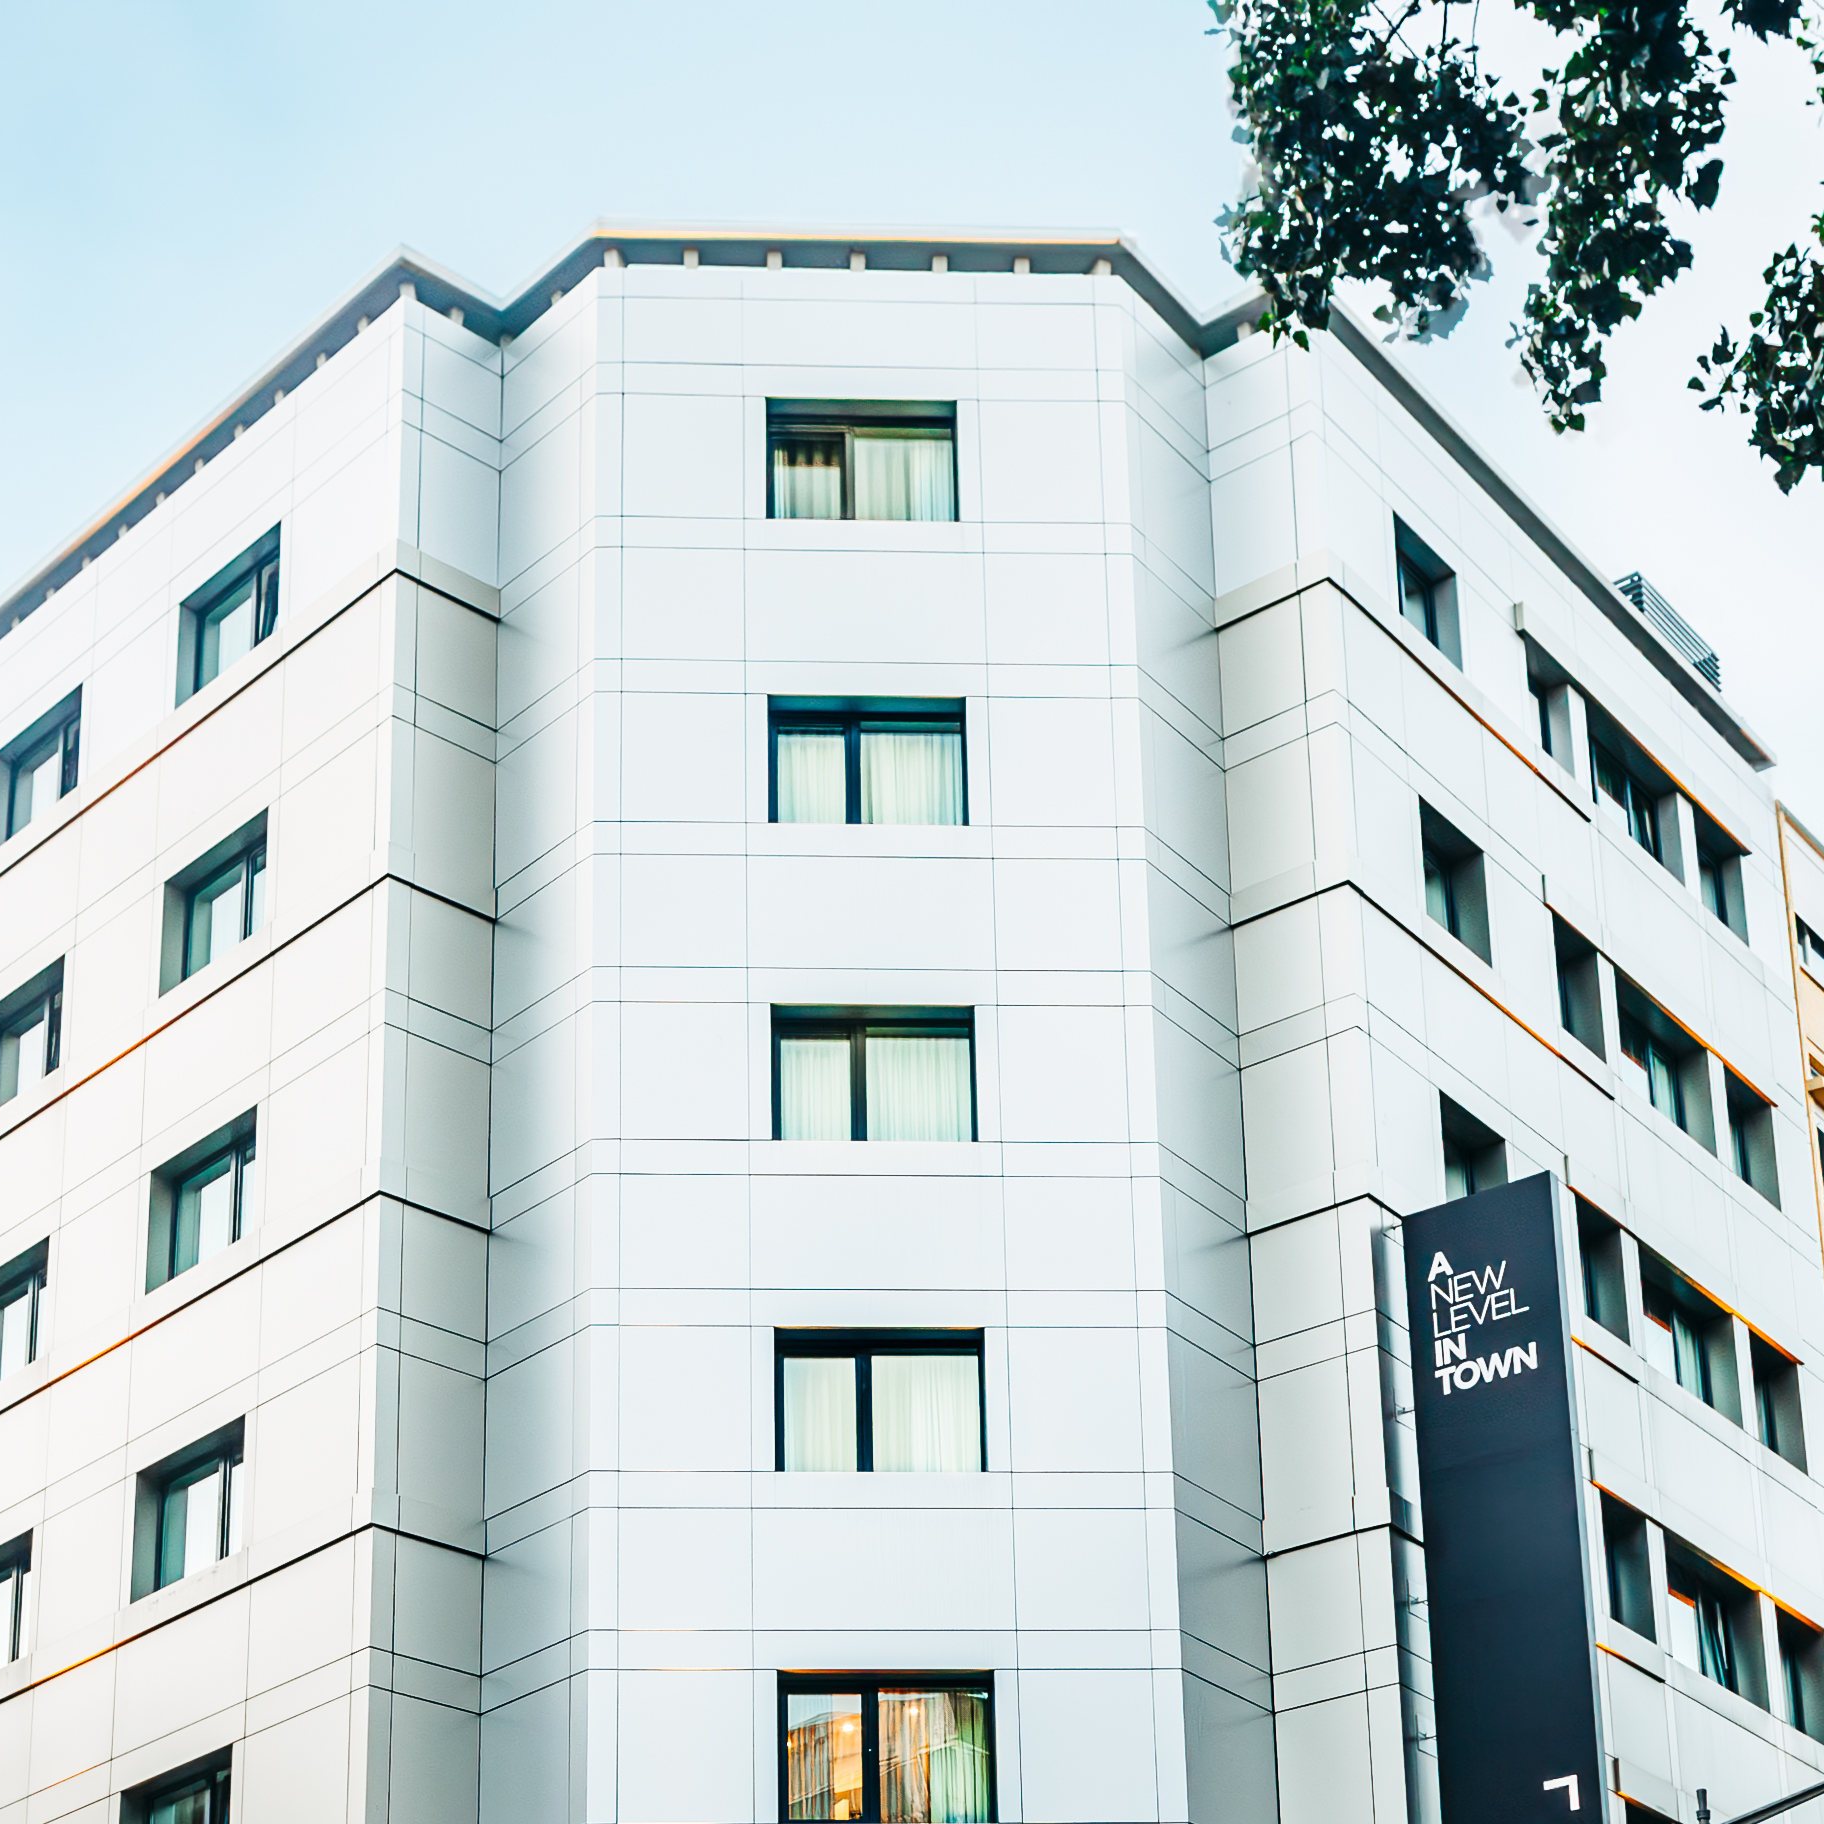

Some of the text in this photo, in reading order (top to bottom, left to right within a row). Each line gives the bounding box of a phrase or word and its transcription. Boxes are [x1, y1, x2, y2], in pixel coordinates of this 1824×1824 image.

[1427, 1250, 1454, 1283] A
[1430, 1259, 1507, 1311] NEW
[1432, 1287, 1530, 1339] LEVEL
[1434, 1332, 1467, 1368] IN
[1434, 1341, 1539, 1396] TOWN
